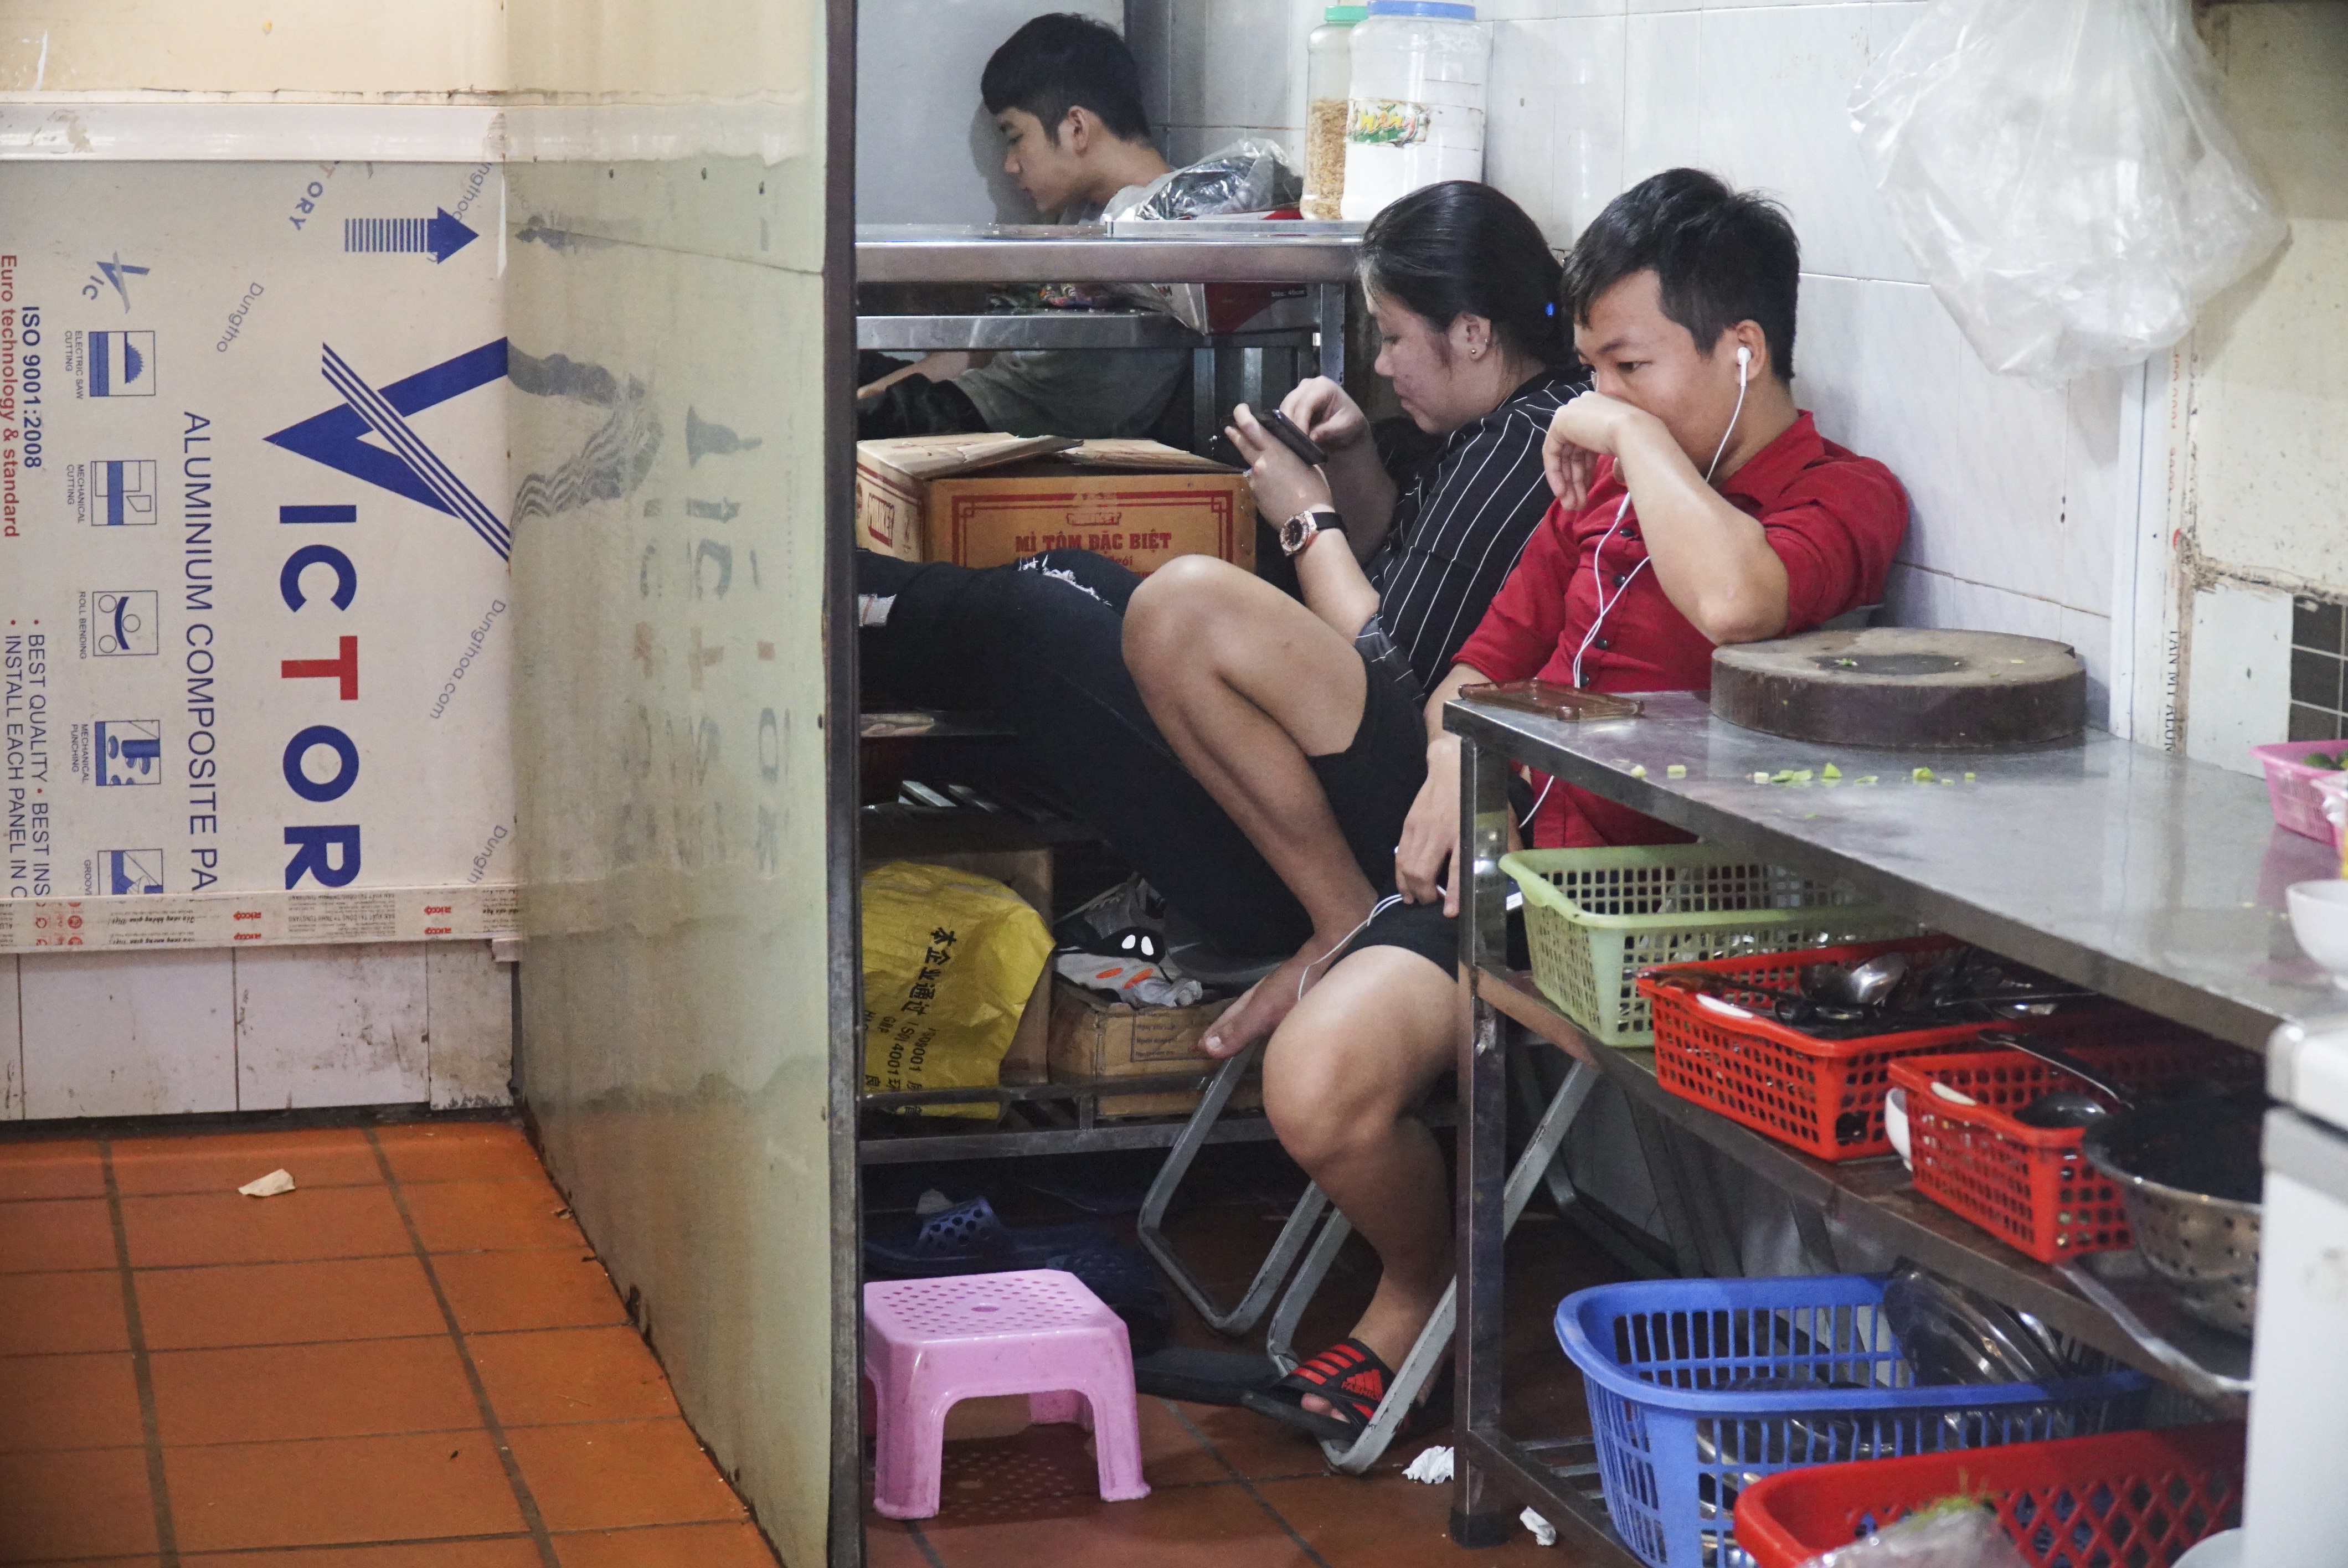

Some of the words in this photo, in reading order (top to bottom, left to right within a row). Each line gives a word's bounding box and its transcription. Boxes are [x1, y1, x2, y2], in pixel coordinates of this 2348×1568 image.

[289, 161, 339, 231] TORY
[0, 255, 16, 302] Euro
[21, 306, 40, 346] ISO
[64, 331, 73, 372] CUTTING
[0, 308, 18, 421] technology
[74, 331, 83, 376] ELECTRIC
[22, 354, 42, 468] 9001:2008
[75, 379, 83, 400] SAW
[3, 428, 18, 442] &
[2, 449, 19, 537] standard
[66, 464, 74, 506] CUTTING
[76, 464, 85, 523] MECHANICAL
[182, 411, 213, 612] ALUMINIUM
[1129, 529, 1172, 552] BIỆT
[28, 635, 44, 688] BEST
[78, 618, 86, 659] BENDING
[428, 599, 507, 721] Dungthoa.com
[4, 636, 22, 719] INSTALL
[6, 724, 24, 780] EACH
[29, 694, 47, 782] QUALITY
[70, 724, 79, 772] PUNCHING
[80, 724, 90, 783] MECHANICAL
[184, 623, 218, 835] COMPOSITE
[8, 787, 25, 853] PANEL
[31, 803, 49, 856] BEST
[10, 859, 27, 879] IN
[188, 847, 219, 891] PA
[901, 927, 957, 1016] 本企业通过
